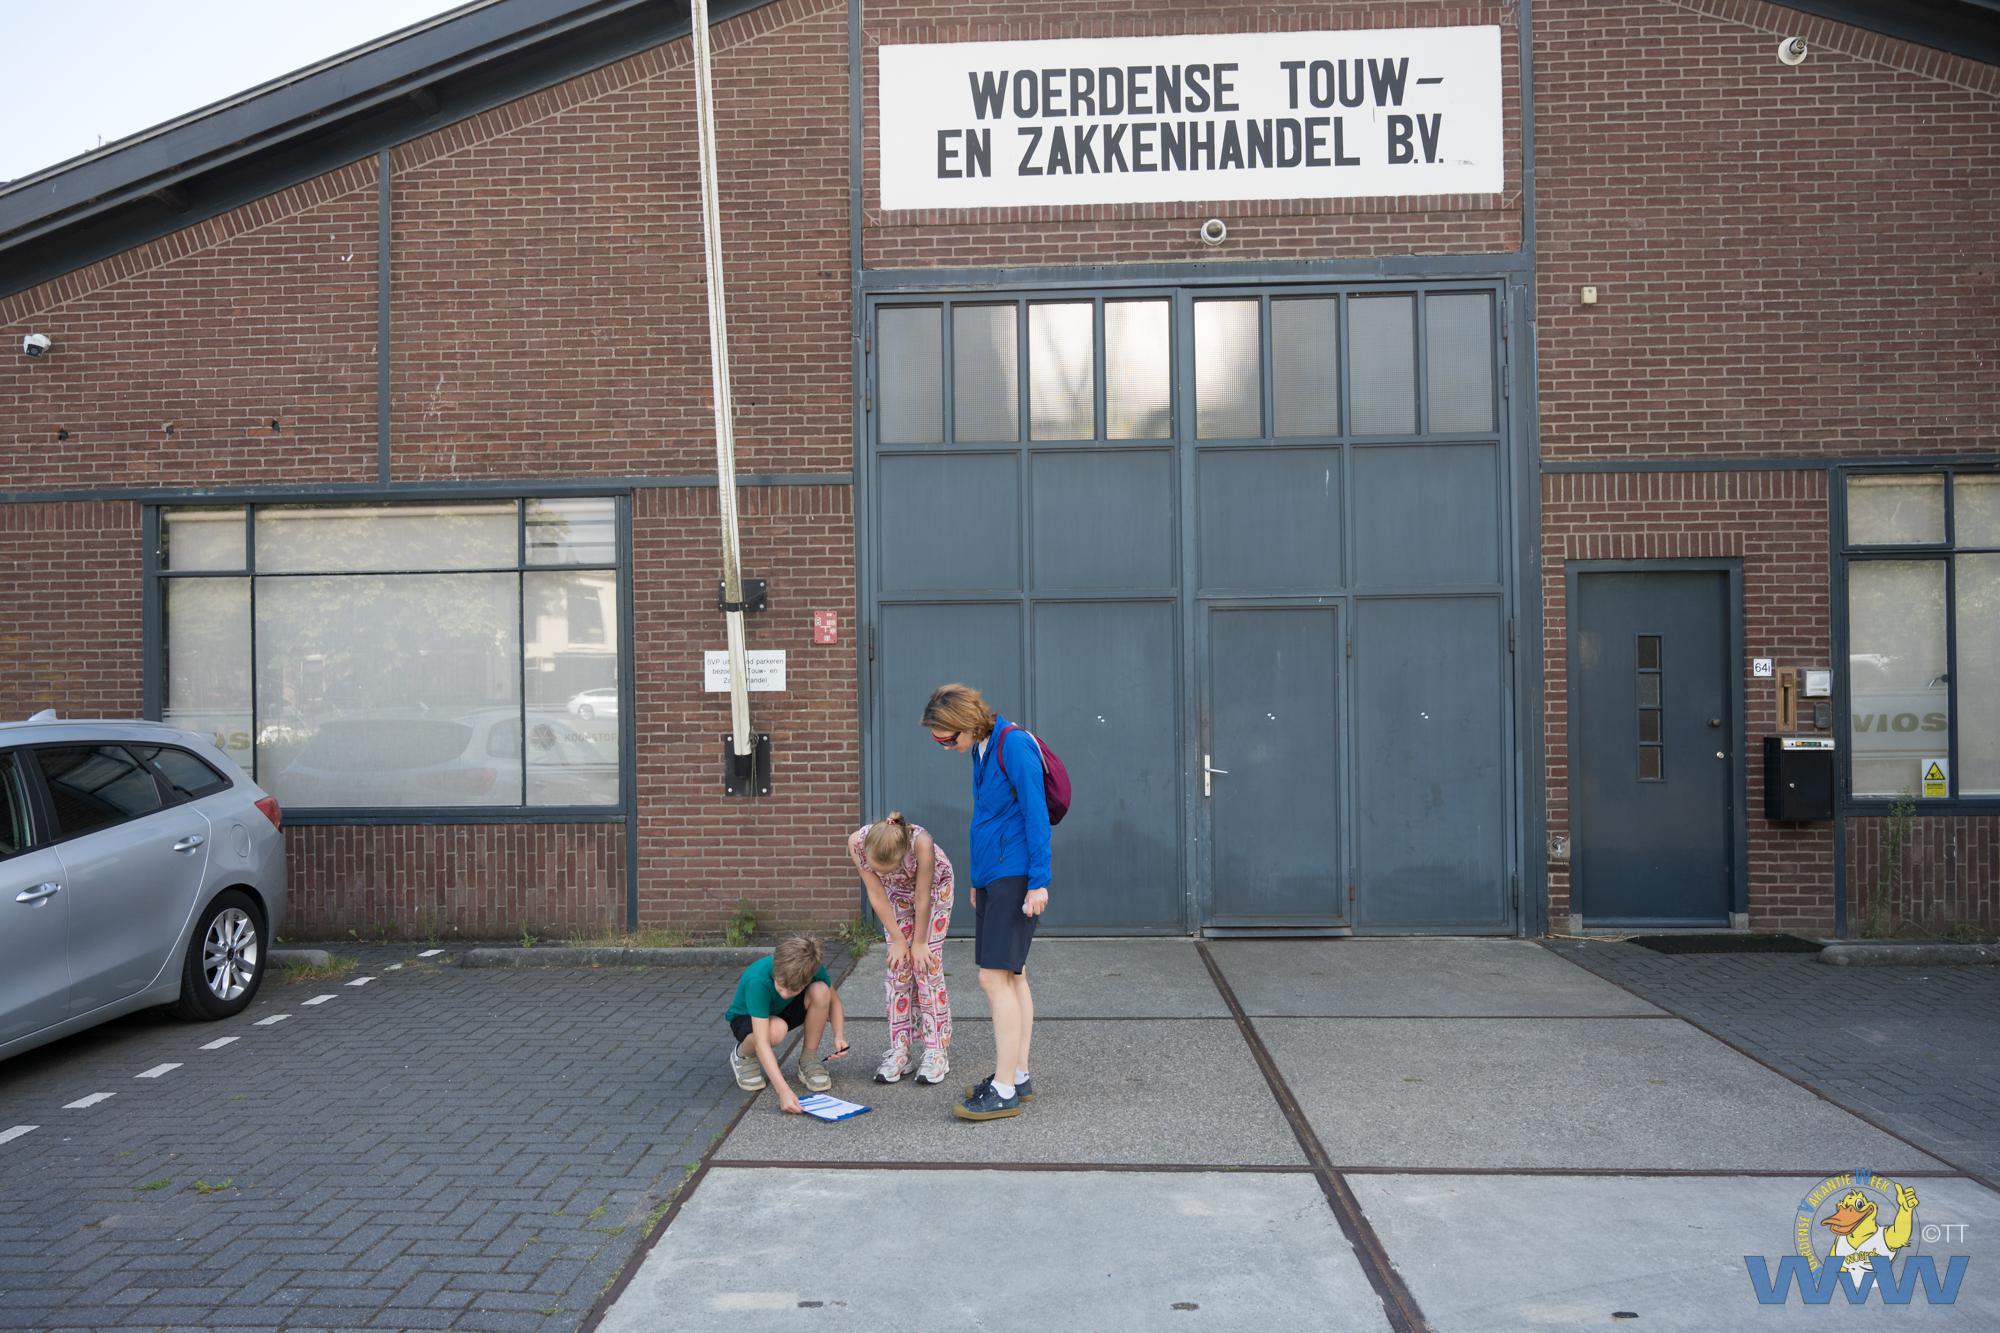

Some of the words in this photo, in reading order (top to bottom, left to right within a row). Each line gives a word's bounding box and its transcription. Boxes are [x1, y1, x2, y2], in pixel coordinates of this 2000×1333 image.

[968, 62, 1239, 120] WOERDENSE
[1280, 57, 1444, 109] TOUW-
[937, 127, 991, 179] EN
[1017, 116, 1360, 176] ZAKKENHANDEL
[1387, 113, 1444, 165] B.V.
[1852, 712, 1947, 732] VIOS
